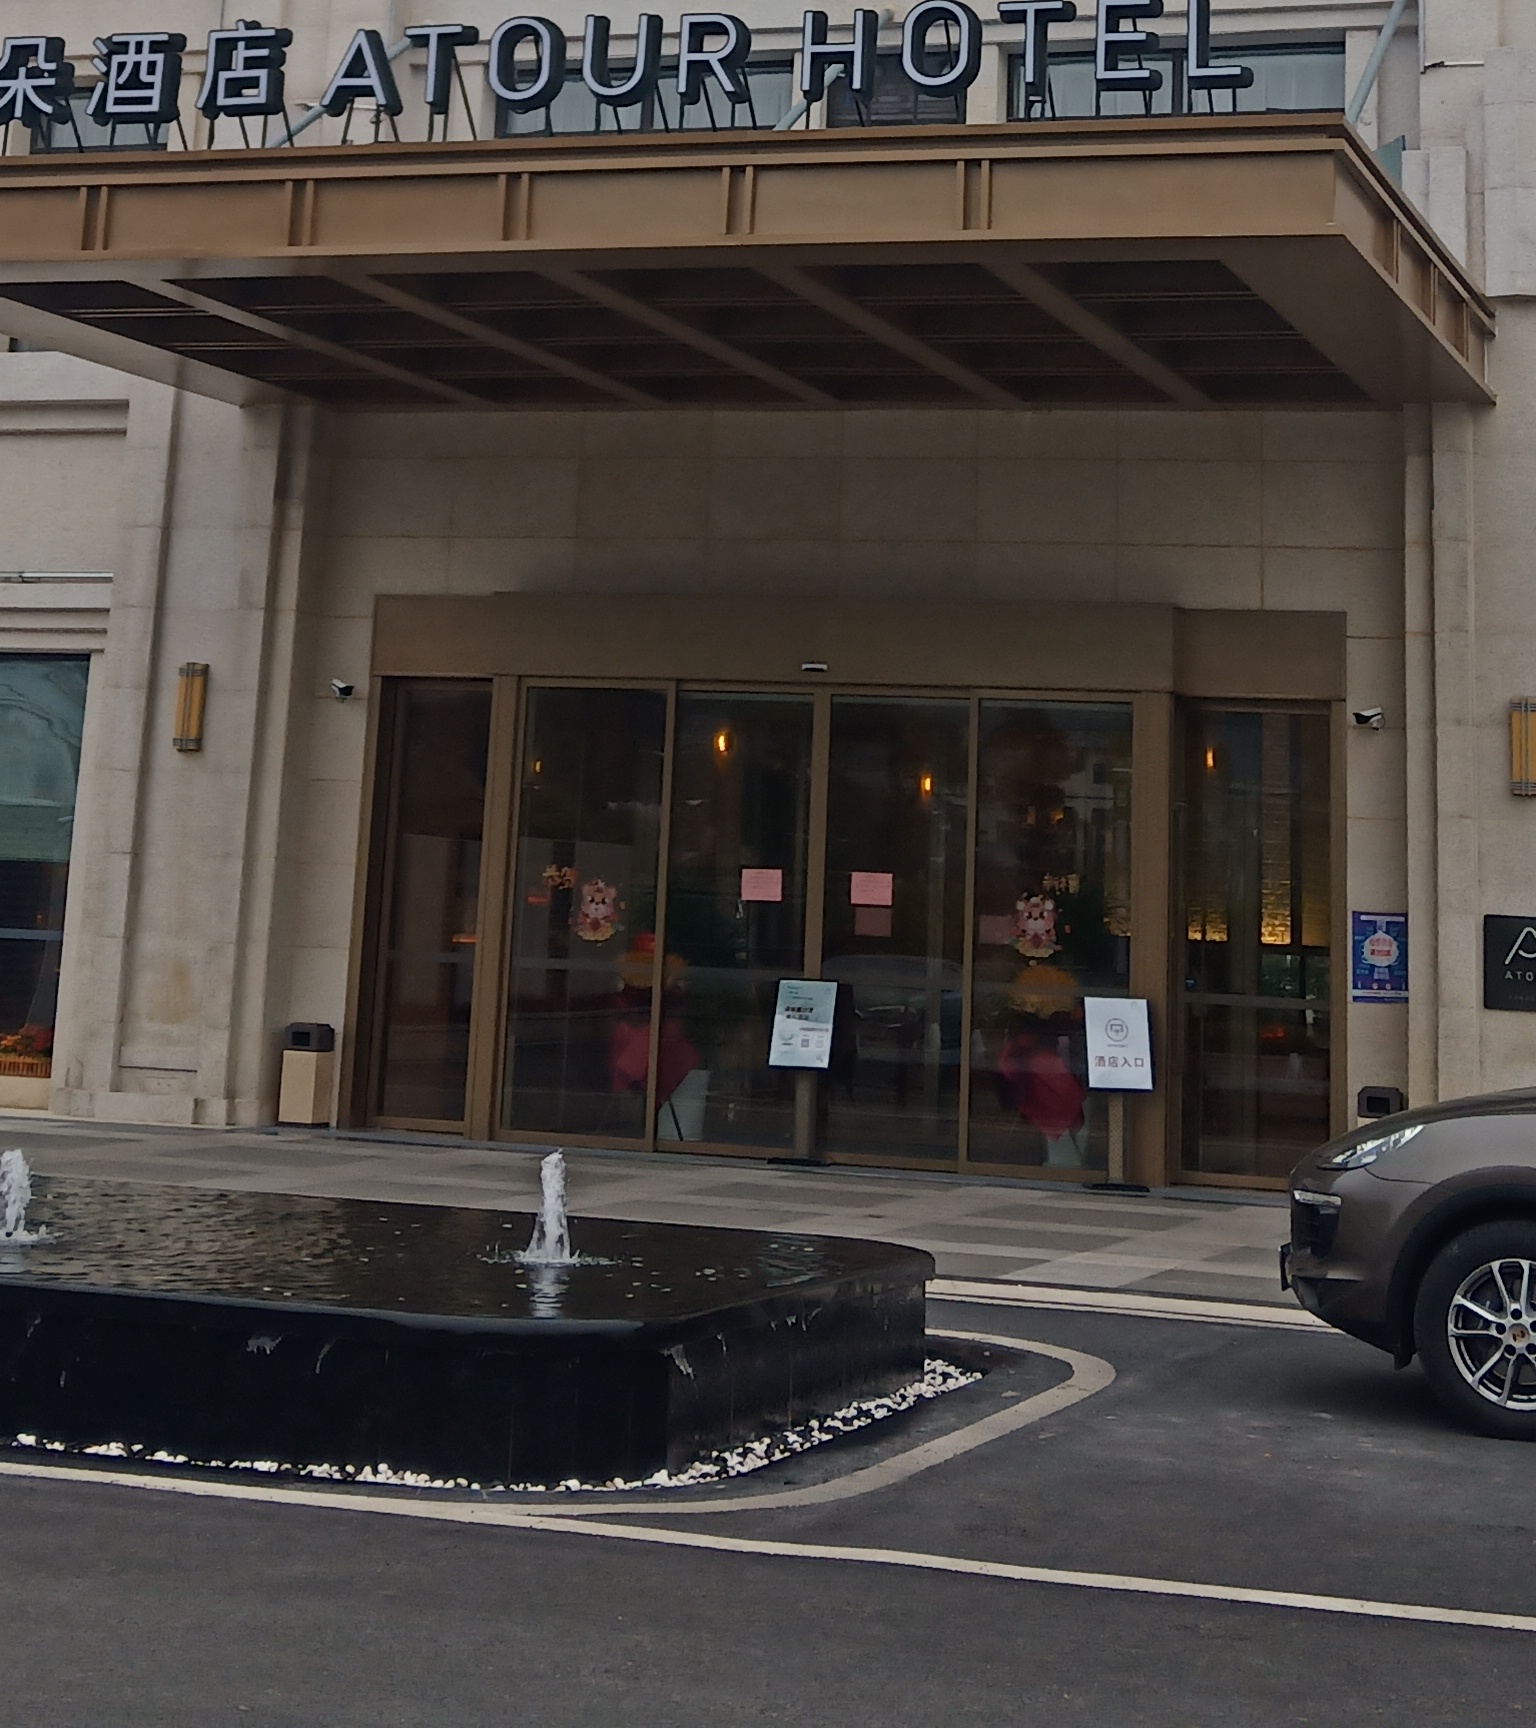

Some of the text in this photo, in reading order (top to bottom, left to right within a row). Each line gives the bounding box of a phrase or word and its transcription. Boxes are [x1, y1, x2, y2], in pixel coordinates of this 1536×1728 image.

[321, 13, 748, 113] ATOUR
[1094, 1055, 1145, 1068] 酒店入口
